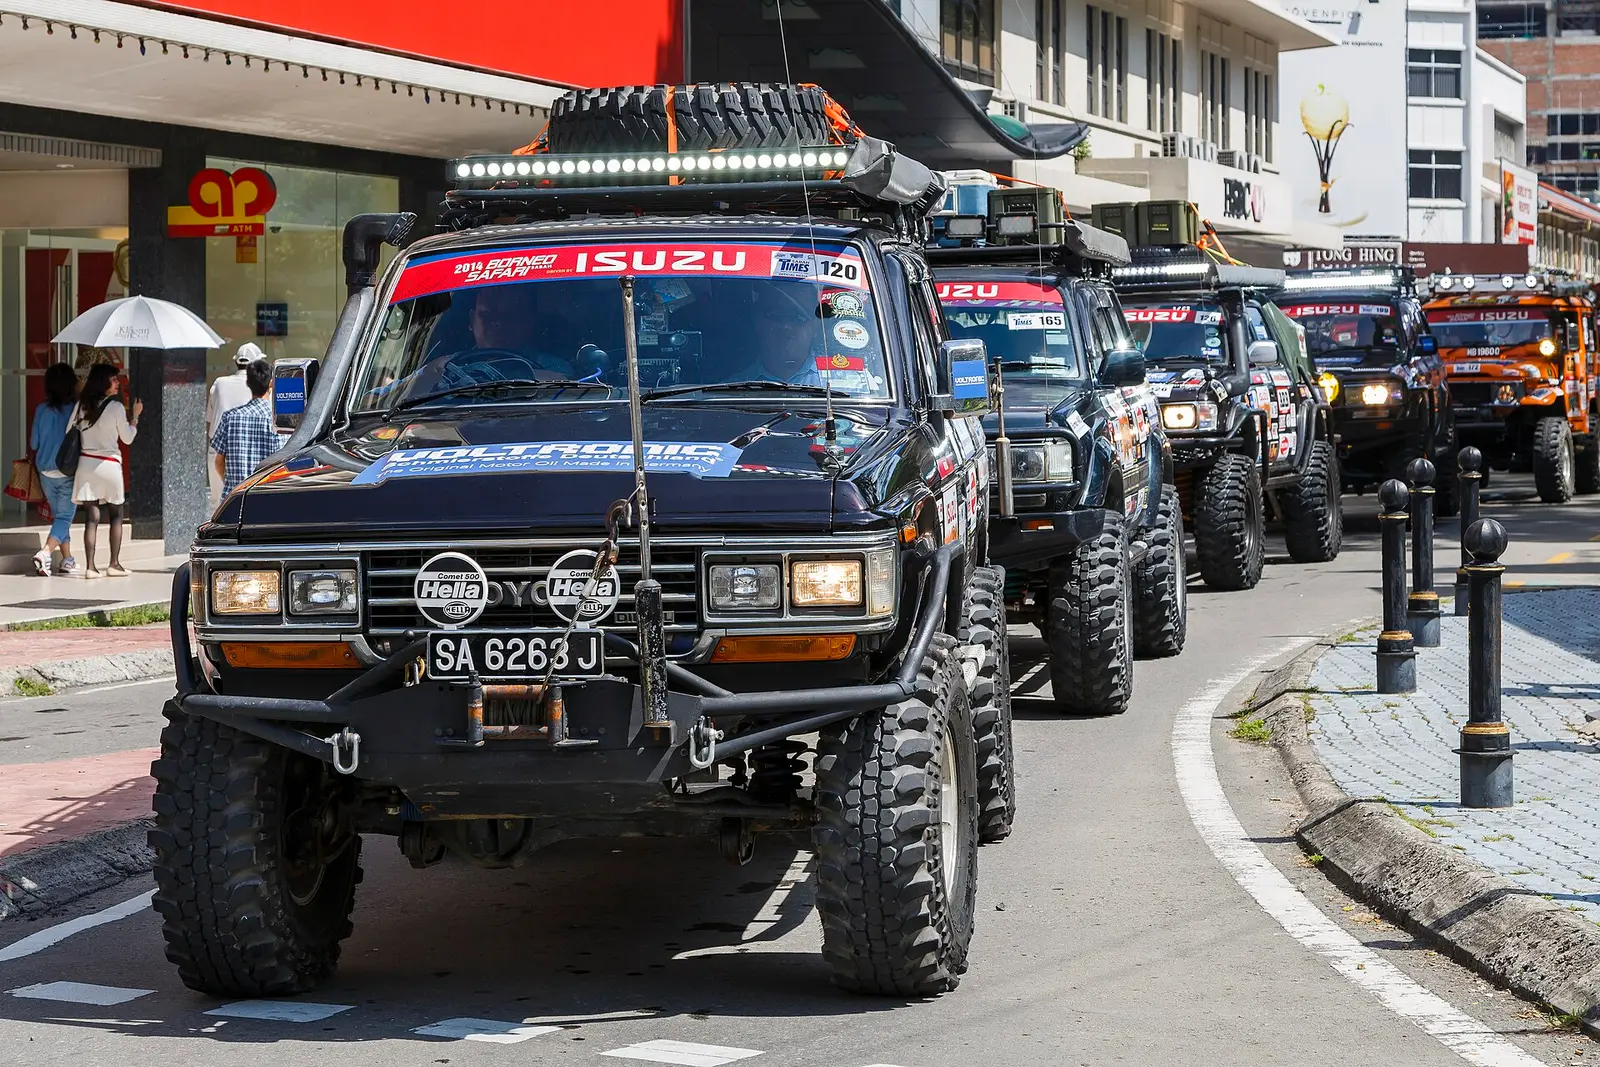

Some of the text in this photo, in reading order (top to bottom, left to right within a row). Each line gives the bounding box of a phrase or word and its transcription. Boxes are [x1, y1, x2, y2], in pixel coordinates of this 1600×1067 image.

[232, 225, 252, 233] ATM
[1359, 248, 1395, 262] HING
[453, 254, 558, 274] 2014 BORNEO
[575, 251, 746, 273] ISUZU
[464, 266, 530, 282] SAFARI
[820, 260, 857, 280] 120
[937, 285, 998, 297] UZU
[1124, 311, 1188, 321] SUZU
[1297, 306, 1354, 316] ISUZU
[1480, 311, 1528, 320] ISUZU
[1039, 315, 1062, 326] 165
[955, 376, 985, 384] VOLTRONIC
[376, 465, 404, 479] The
[409, 463, 474, 473] Original
[479, 460, 530, 468] Motor
[570, 570, 593, 578] Come
[421, 581, 480, 599] Hella
[552, 579, 613, 597] Hela
[445, 606, 471, 615] HELLA
[579, 603, 603, 611] ELLA
[435, 638, 597, 671] SA 6263 J
